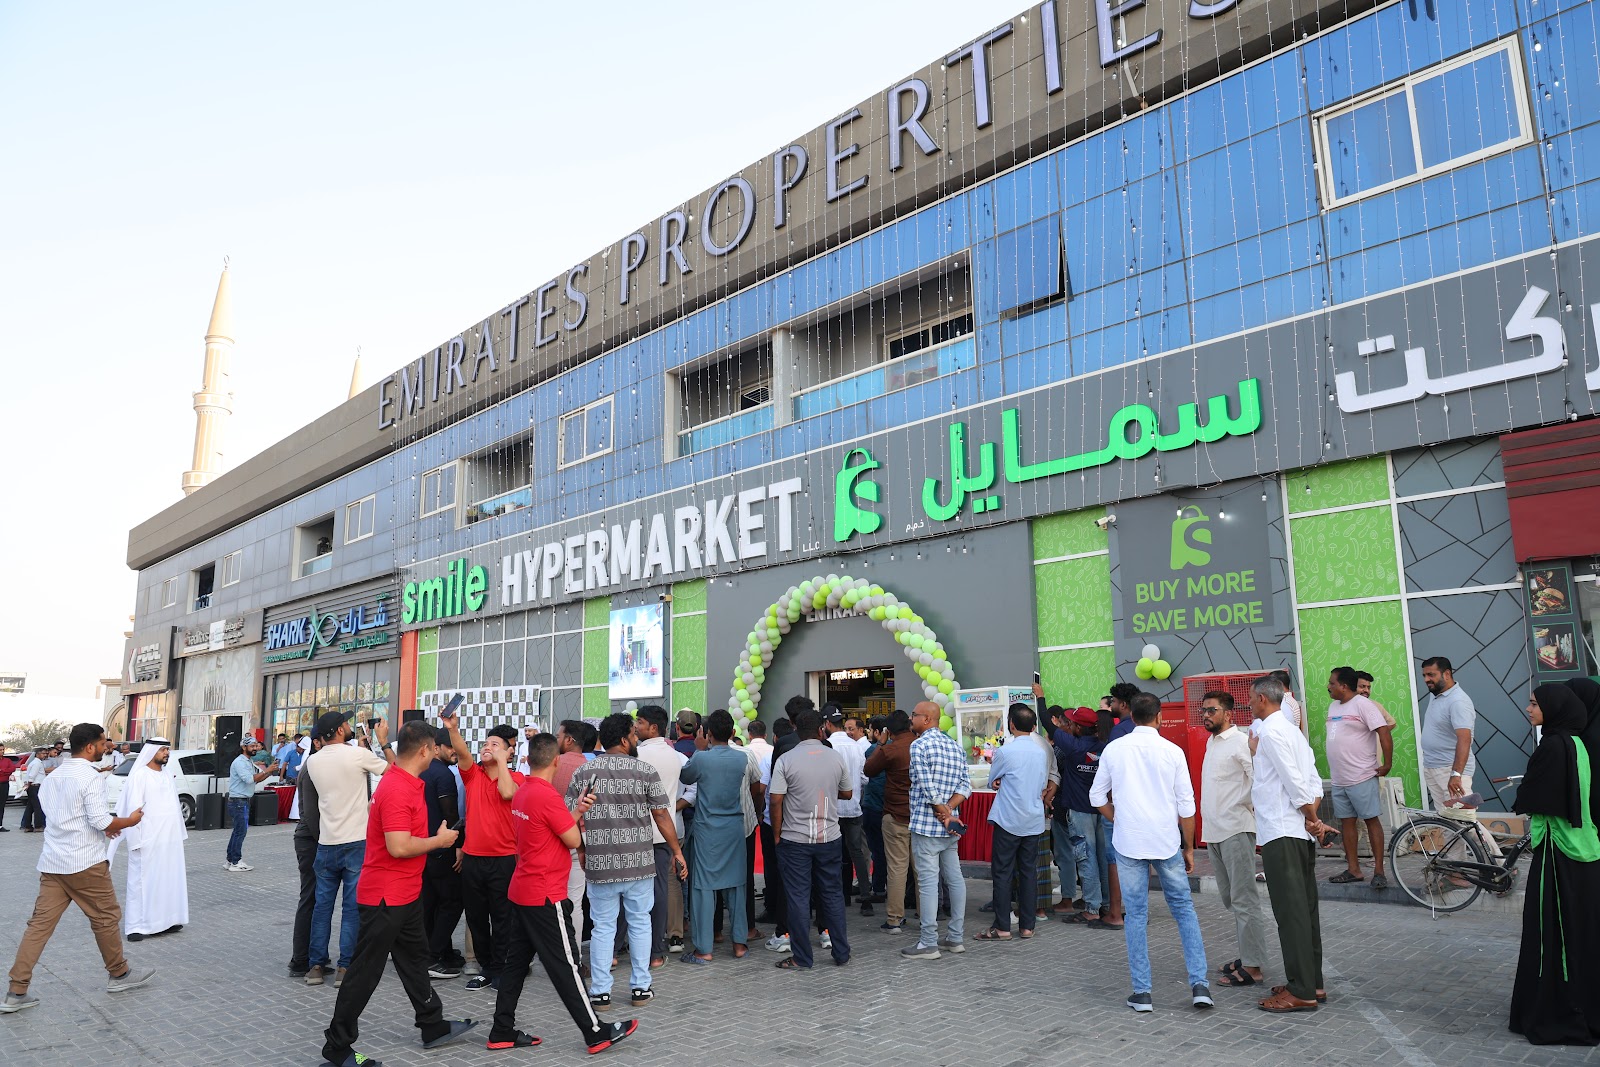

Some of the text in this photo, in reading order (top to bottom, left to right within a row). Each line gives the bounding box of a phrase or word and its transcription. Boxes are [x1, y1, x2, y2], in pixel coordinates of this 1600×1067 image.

[378, 0, 1244, 431] EMIRATES PROPERTIE
[921, 377, 1263, 522] سمايل
[402, 557, 490, 626] smile
[501, 476, 803, 607] HYPERMARKET
[1135, 569, 1256, 604] BUY MORE
[264, 617, 308, 651] SHARK
[340, 601, 388, 635] شارك
[1132, 601, 1264, 634] SAVE MORE
[830, 669, 869, 680] FARM FRESH
[608, 756, 637, 771] GERF
[607, 778, 635, 795] GERF
[608, 803, 637, 819] GERF
[611, 827, 638, 845] GERF
[612, 852, 641, 870] GERF
